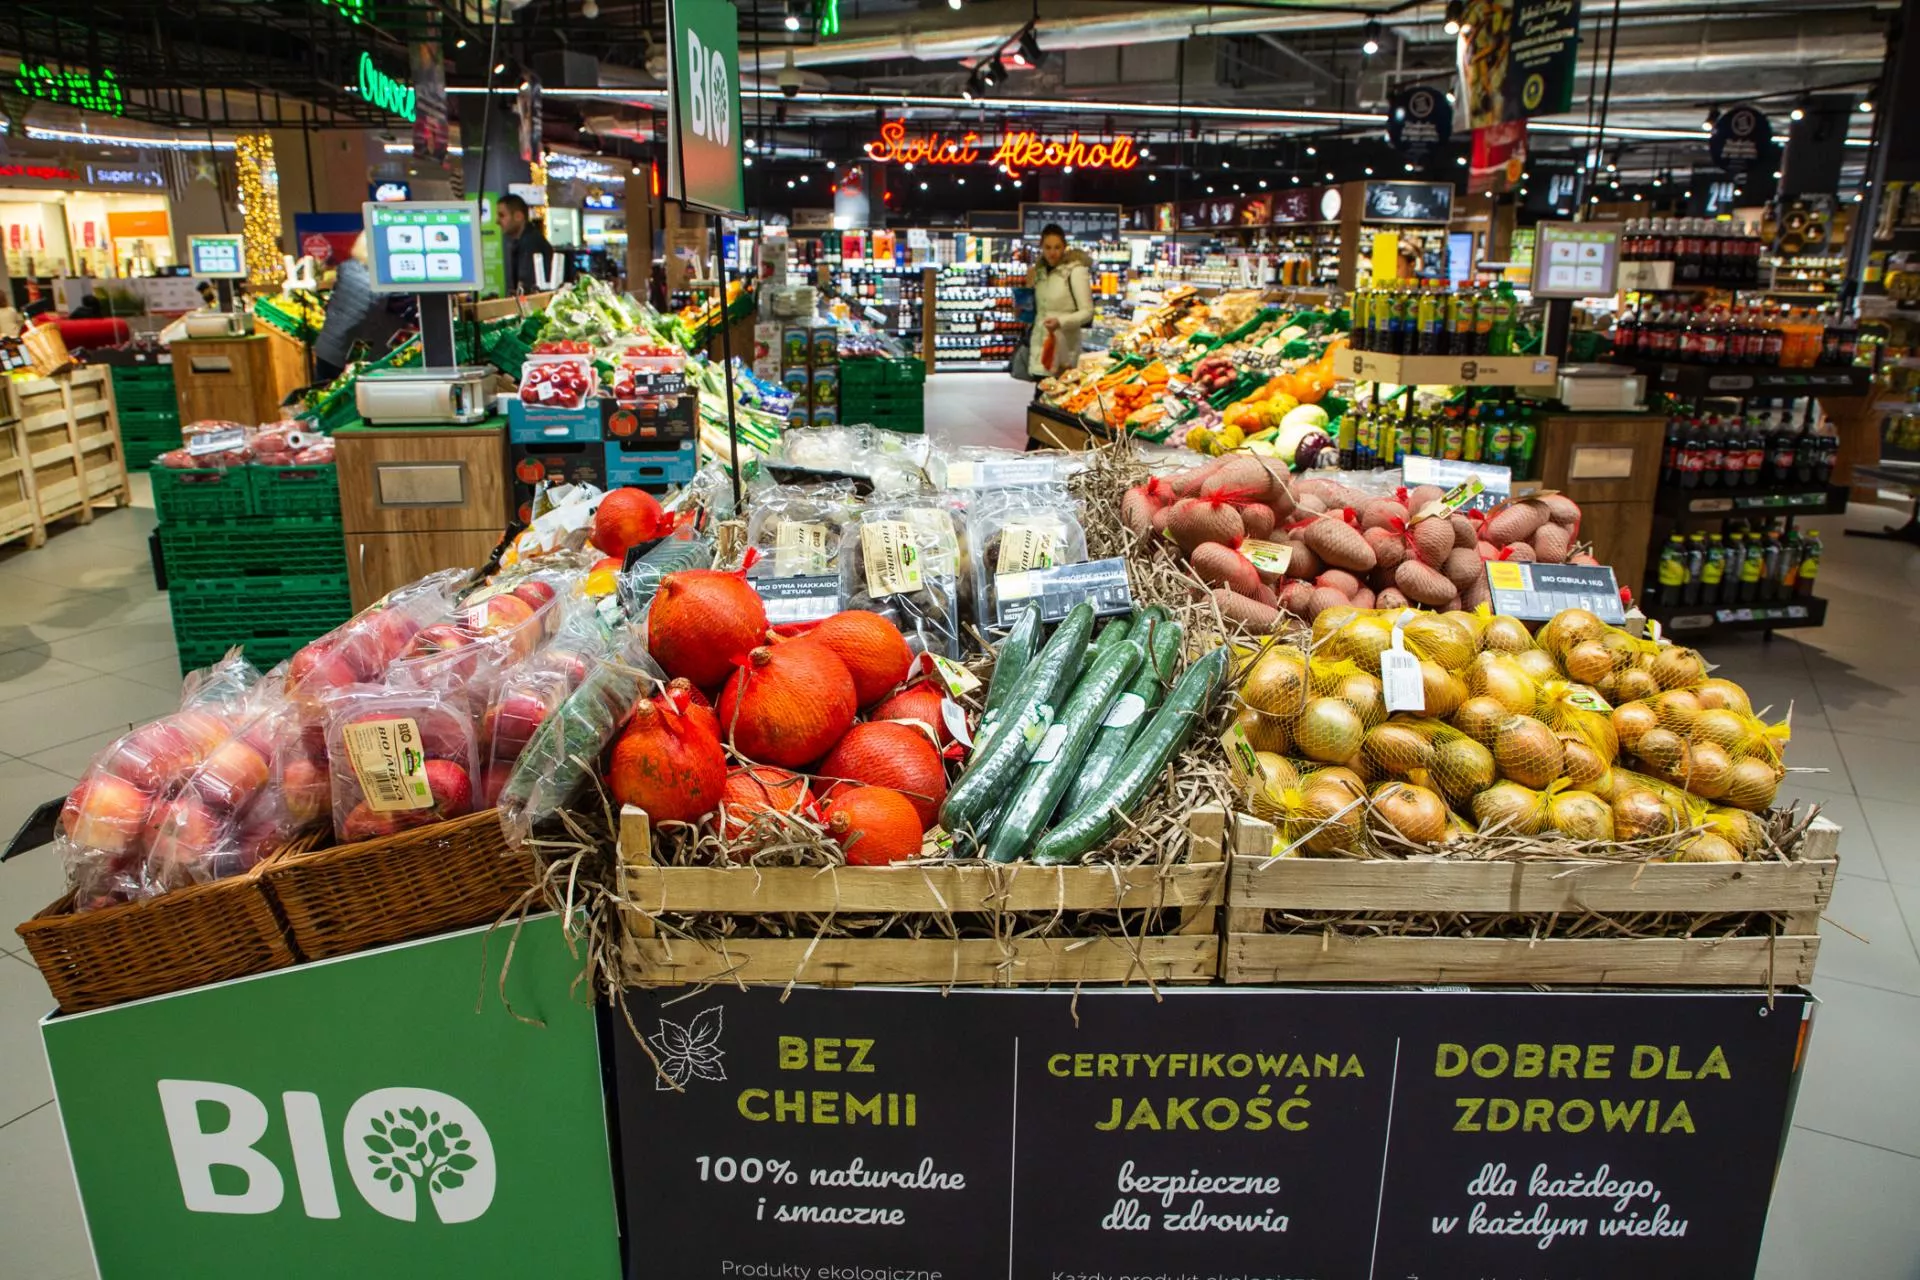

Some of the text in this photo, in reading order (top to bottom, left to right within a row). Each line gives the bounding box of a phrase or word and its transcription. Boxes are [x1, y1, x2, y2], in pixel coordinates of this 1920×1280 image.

[688, 28, 730, 147] BIO
[989, 132, 1138, 178] Alkoholi
[1556, 576, 1587, 585] CEBULA
[377, 726, 391, 751] BIO
[398, 723, 413, 744] BIO
[779, 1036, 876, 1073] BEZ
[1047, 1053, 1366, 1079] CERTYFIKOWANA
[1435, 1043, 1732, 1080] DOBRE DLA
[737, 1088, 917, 1127] CHEMII
[1095, 1084, 1312, 1131] JAKOŚĆ
[1452, 1097, 1696, 1134] ZDROWIA
[157, 1079, 497, 1224] BIO
[696, 1156, 966, 1190] 100% naturalne
[1117, 1160, 1281, 1207] bezpieczne
[1467, 1162, 1662, 1212] dla każdego,
[756, 1196, 906, 1226] i smaczne
[1101, 1199, 1290, 1232] dla zdrowia
[1432, 1201, 1689, 1250] w każdym wieku
[722, 1260, 811, 1280] Produkty
